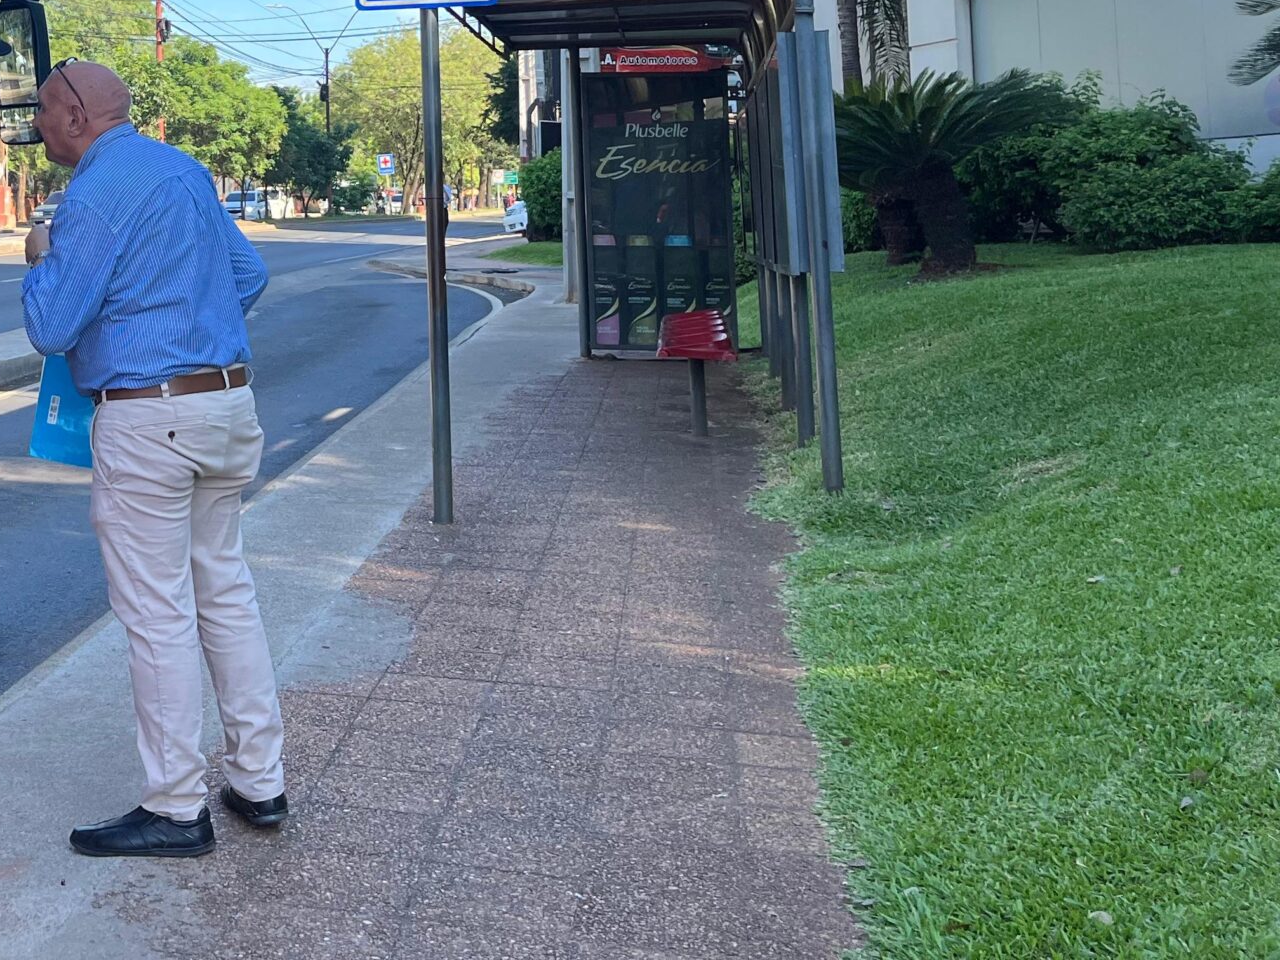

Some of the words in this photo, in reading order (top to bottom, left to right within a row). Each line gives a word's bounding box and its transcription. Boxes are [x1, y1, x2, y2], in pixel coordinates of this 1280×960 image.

[620, 55, 698, 65] Automotores
[625, 123, 689, 138] Plusbelle
[595, 144, 720, 180] Esencia
